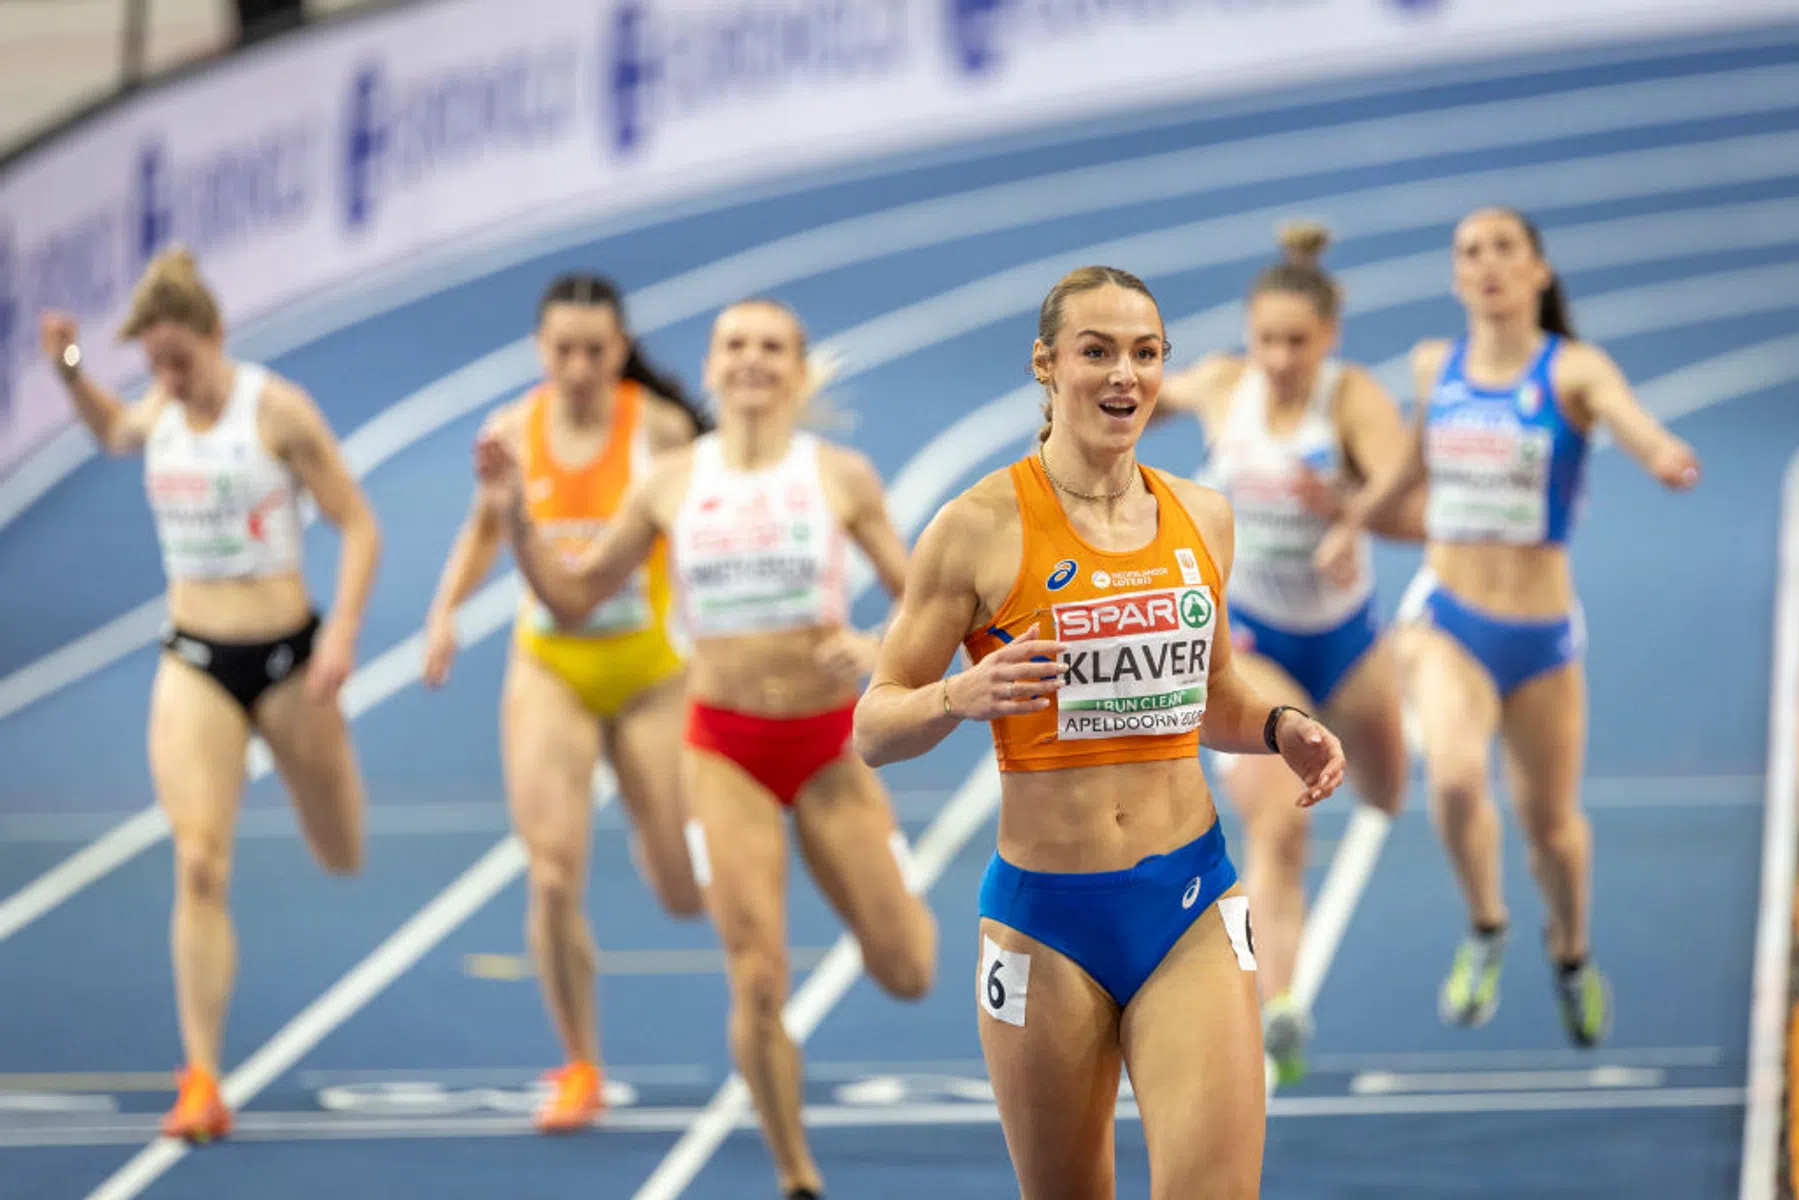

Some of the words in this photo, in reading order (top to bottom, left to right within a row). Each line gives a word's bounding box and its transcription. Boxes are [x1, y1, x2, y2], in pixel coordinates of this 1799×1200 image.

[1062, 600, 1176, 636] SPAR
[1063, 639, 1206, 686] KLAVER
[1104, 700, 1138, 713] RUN
[1140, 691, 1183, 710] CLEAN
[1065, 713, 1178, 732] APELDOORN
[987, 959, 1006, 1010] 6
